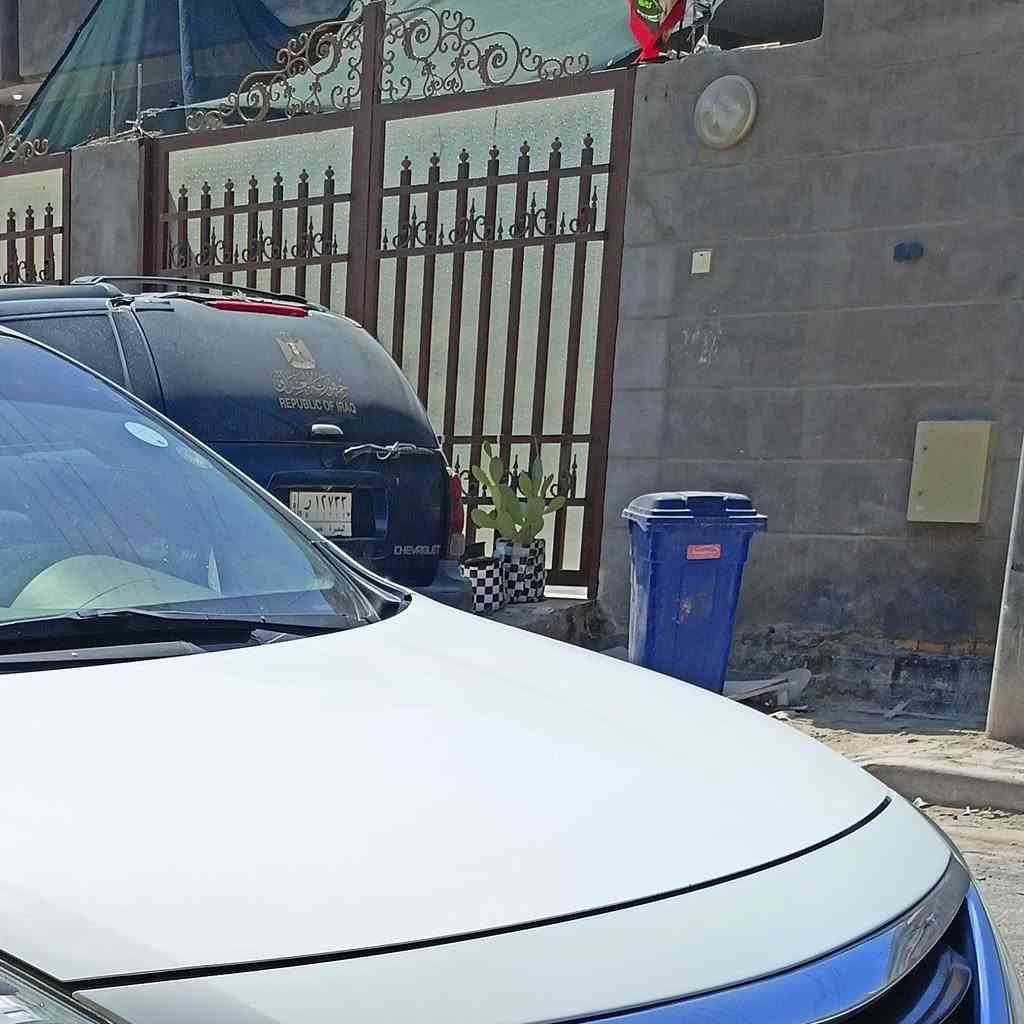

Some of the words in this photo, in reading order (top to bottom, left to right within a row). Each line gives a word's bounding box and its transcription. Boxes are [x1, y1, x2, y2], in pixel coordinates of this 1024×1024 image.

[279, 398, 322, 410] REPUBLIC
[323, 399, 335, 411] OF
[336, 400, 356, 414] IRAQ
[393, 545, 441, 556] CHEVROLET
